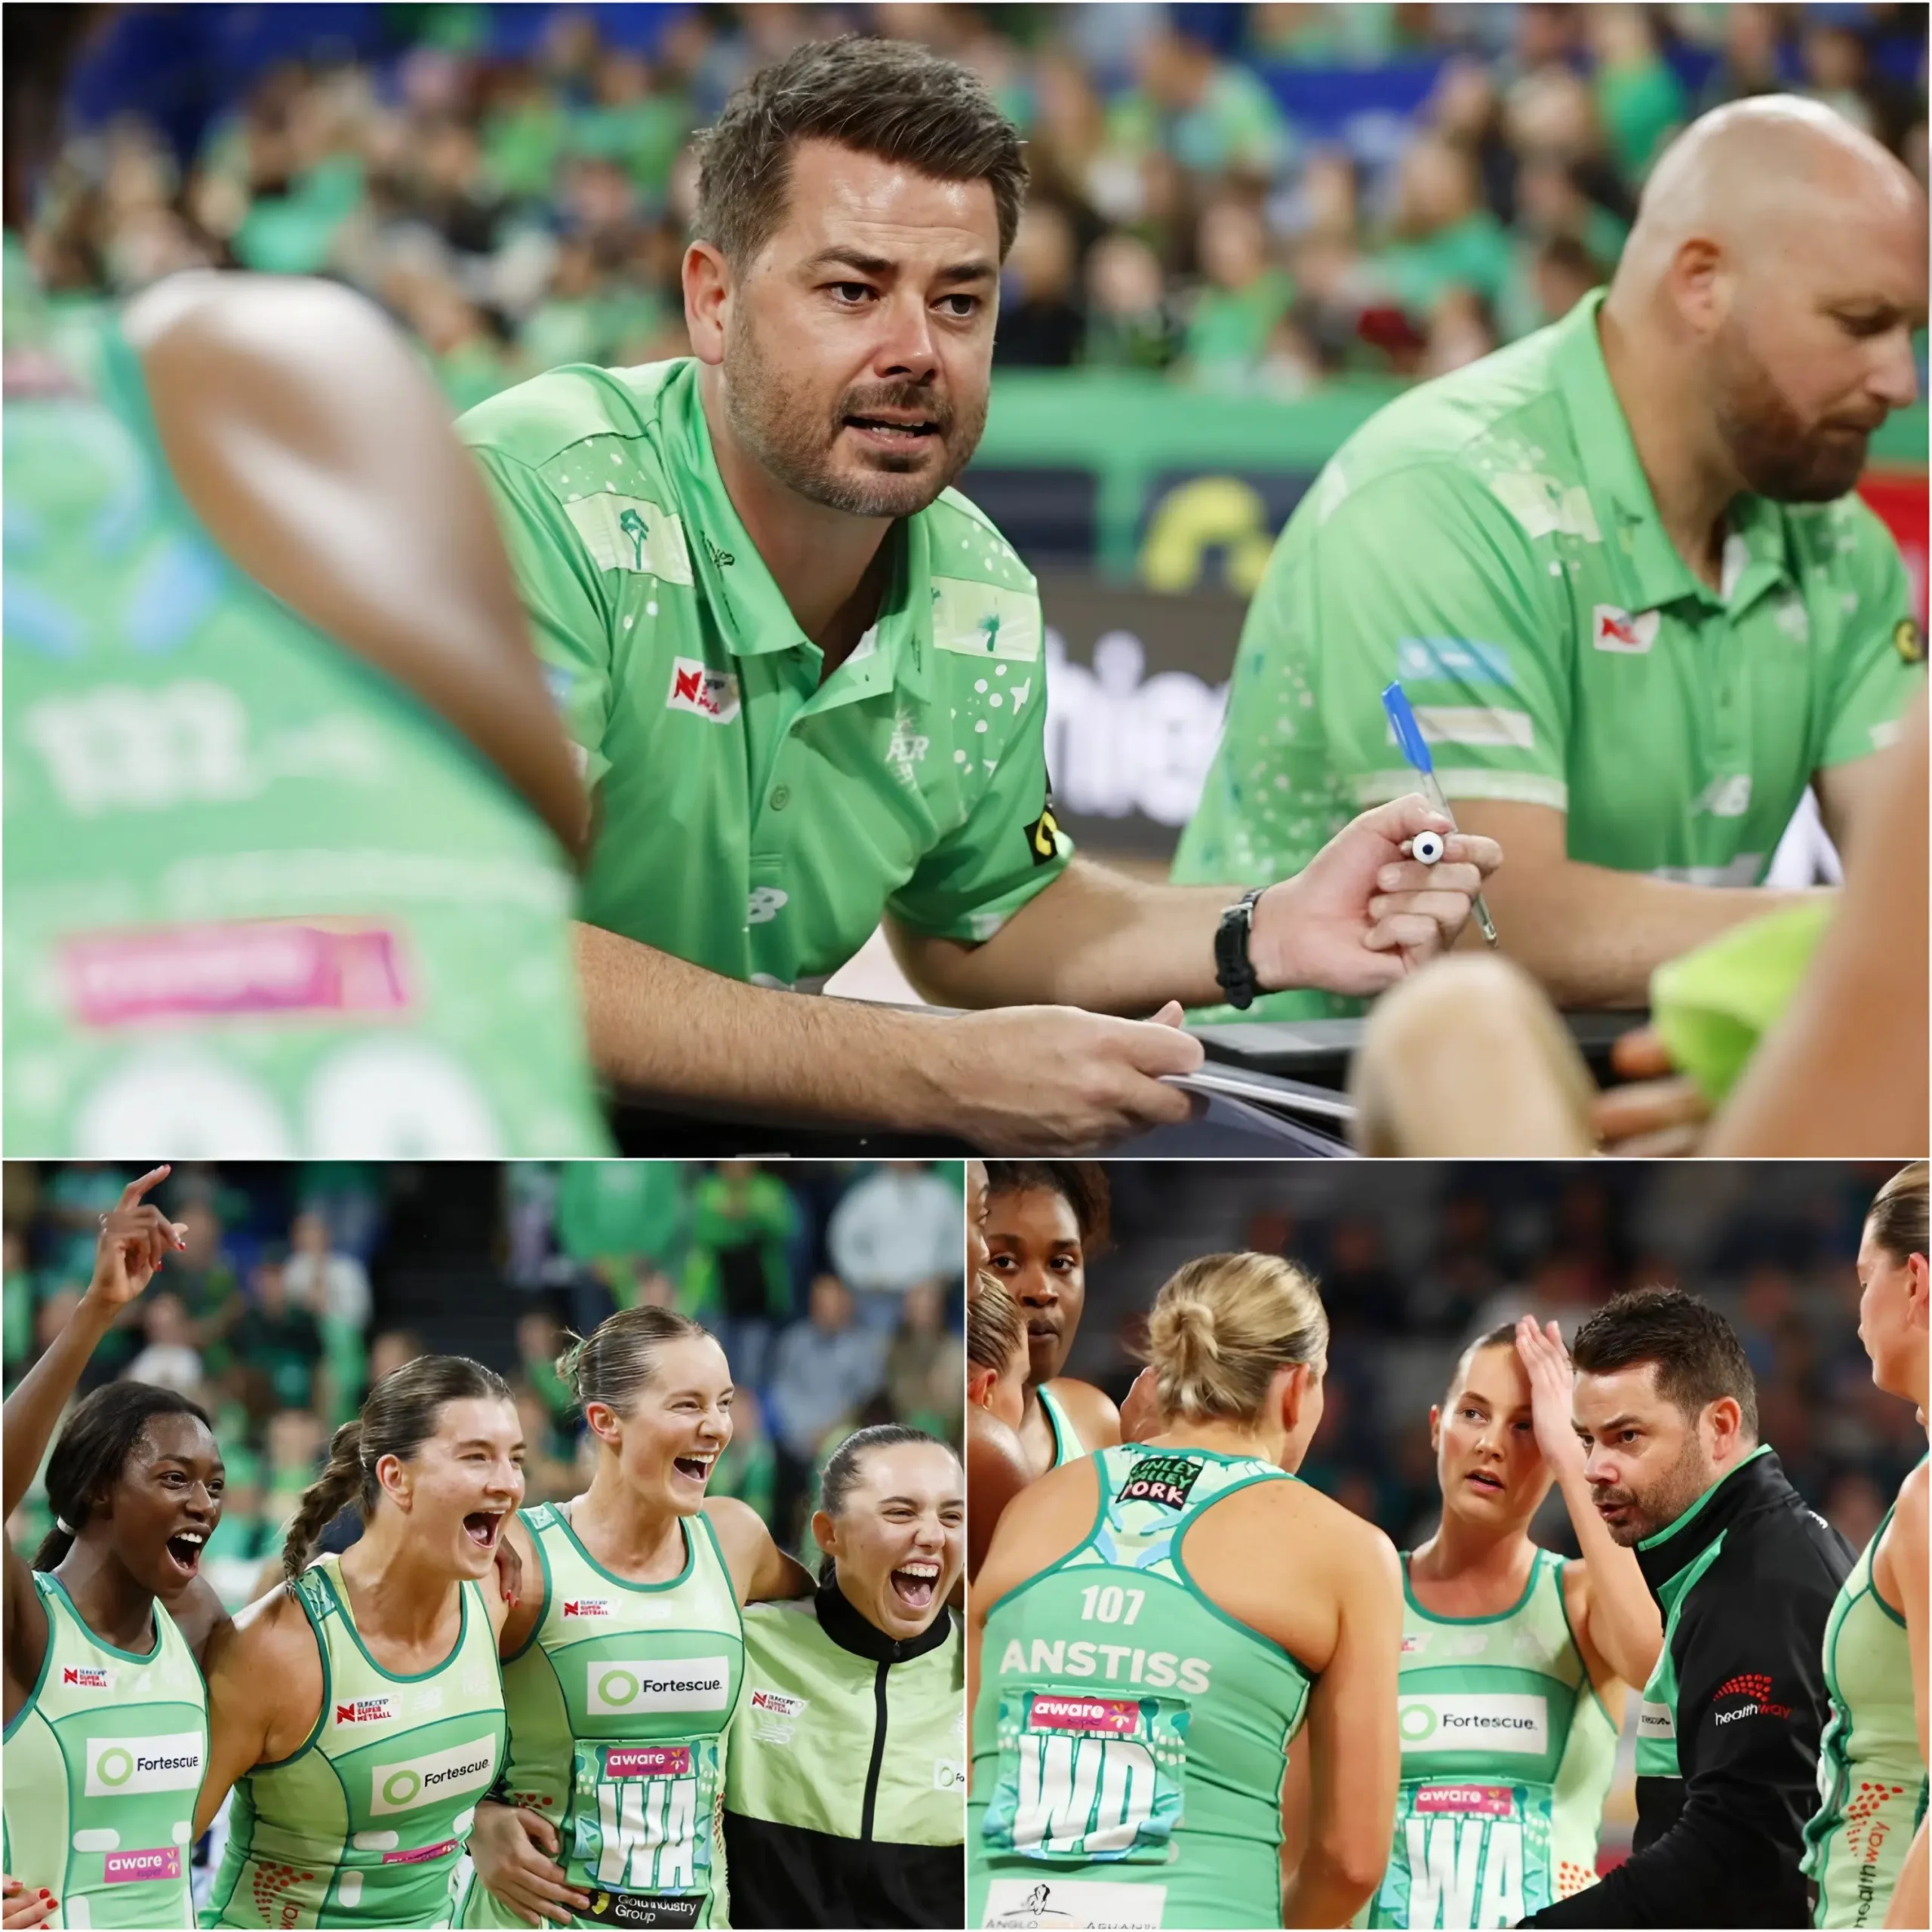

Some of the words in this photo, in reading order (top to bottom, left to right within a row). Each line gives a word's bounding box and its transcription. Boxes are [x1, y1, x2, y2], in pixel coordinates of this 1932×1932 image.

[1081, 1585, 1146, 1626] 107
[999, 1638, 1212, 1694] ANSTISS
[642, 1679, 721, 1693] Fortescue
[1035, 1702, 1105, 1719] aware
[1715, 1703, 1792, 1727] healthway
[1442, 1714, 1534, 1730] Fortescue
[137, 1755, 198, 1772] Fortescue
[610, 1753, 665, 1766] aware
[424, 1758, 489, 1788] Fortescue
[1012, 1734, 1157, 1852] WD
[1419, 1789, 1481, 1803] aware
[597, 1778, 697, 1888] WA
[108, 1855, 162, 1871] aware
[1404, 1818, 1526, 1929] WA
[615, 1904, 656, 1924] Group
